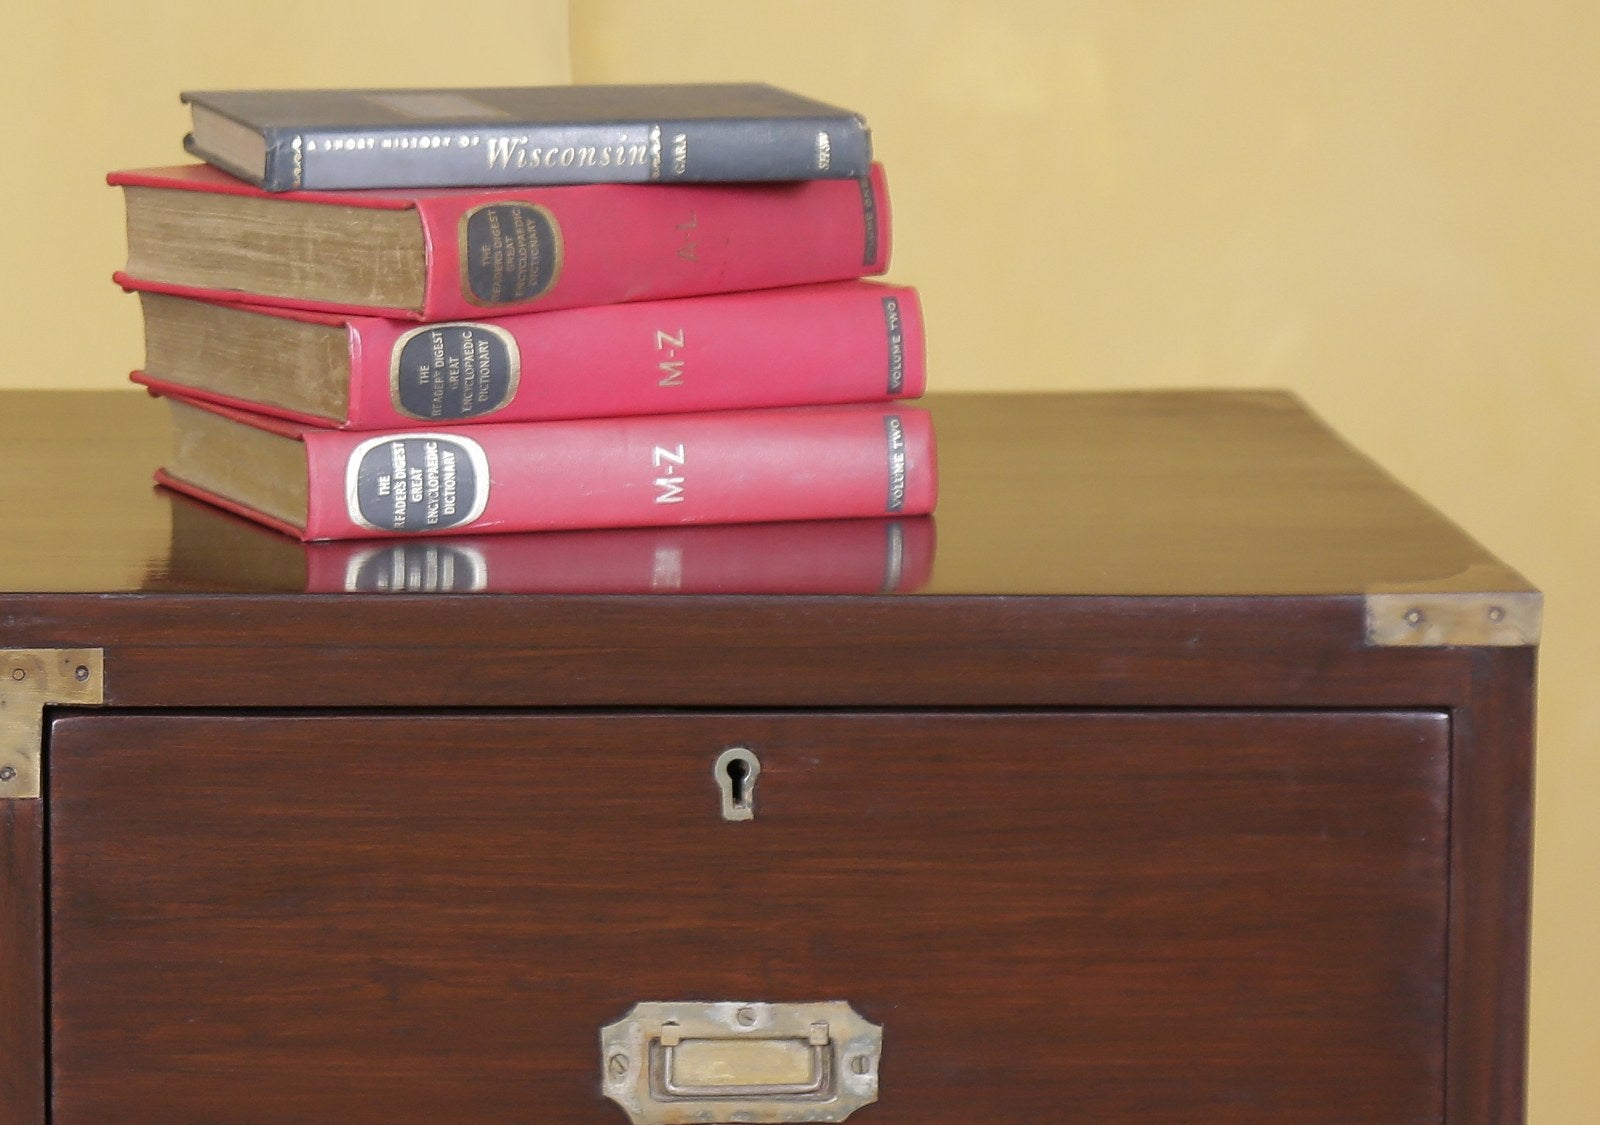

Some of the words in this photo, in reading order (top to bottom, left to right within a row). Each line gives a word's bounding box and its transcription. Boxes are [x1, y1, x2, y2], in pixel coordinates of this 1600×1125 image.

[306, 140, 316, 151] A
[324, 137, 375, 151] SHORT
[382, 135, 450, 150] HISTORY
[458, 134, 480, 149] OF
[487, 136, 649, 169] Wisconsin
[488, 209, 502, 249] DIGEST
[513, 208, 528, 296] ENCYCLOPAEDIC
[527, 218, 540, 286] DICTIONARY
[676, 209, 699, 263] A-L
[482, 244, 491, 267] THE
[505, 235, 515, 272] GREAT
[887, 302, 899, 330] TWO
[432, 331, 445, 368] DIGEST
[462, 330, 475, 413] ENCYCLOPAEDIC
[478, 340, 491, 402] DICTIONARY
[656, 328, 685, 387] M-Z
[891, 334, 903, 389] VOLUME
[420, 364, 430, 385] THE
[890, 419, 904, 450] TWO
[393, 442, 407, 481] DIGEST
[410, 467, 423, 503] GREAT
[426, 442, 440, 525] ENCYCLOPAEDIC
[442, 450, 456, 515] DICTIONARY
[655, 444, 685, 504] M-Z
[891, 453, 905, 508] VOLUME
[380, 475, 391, 496] THE
